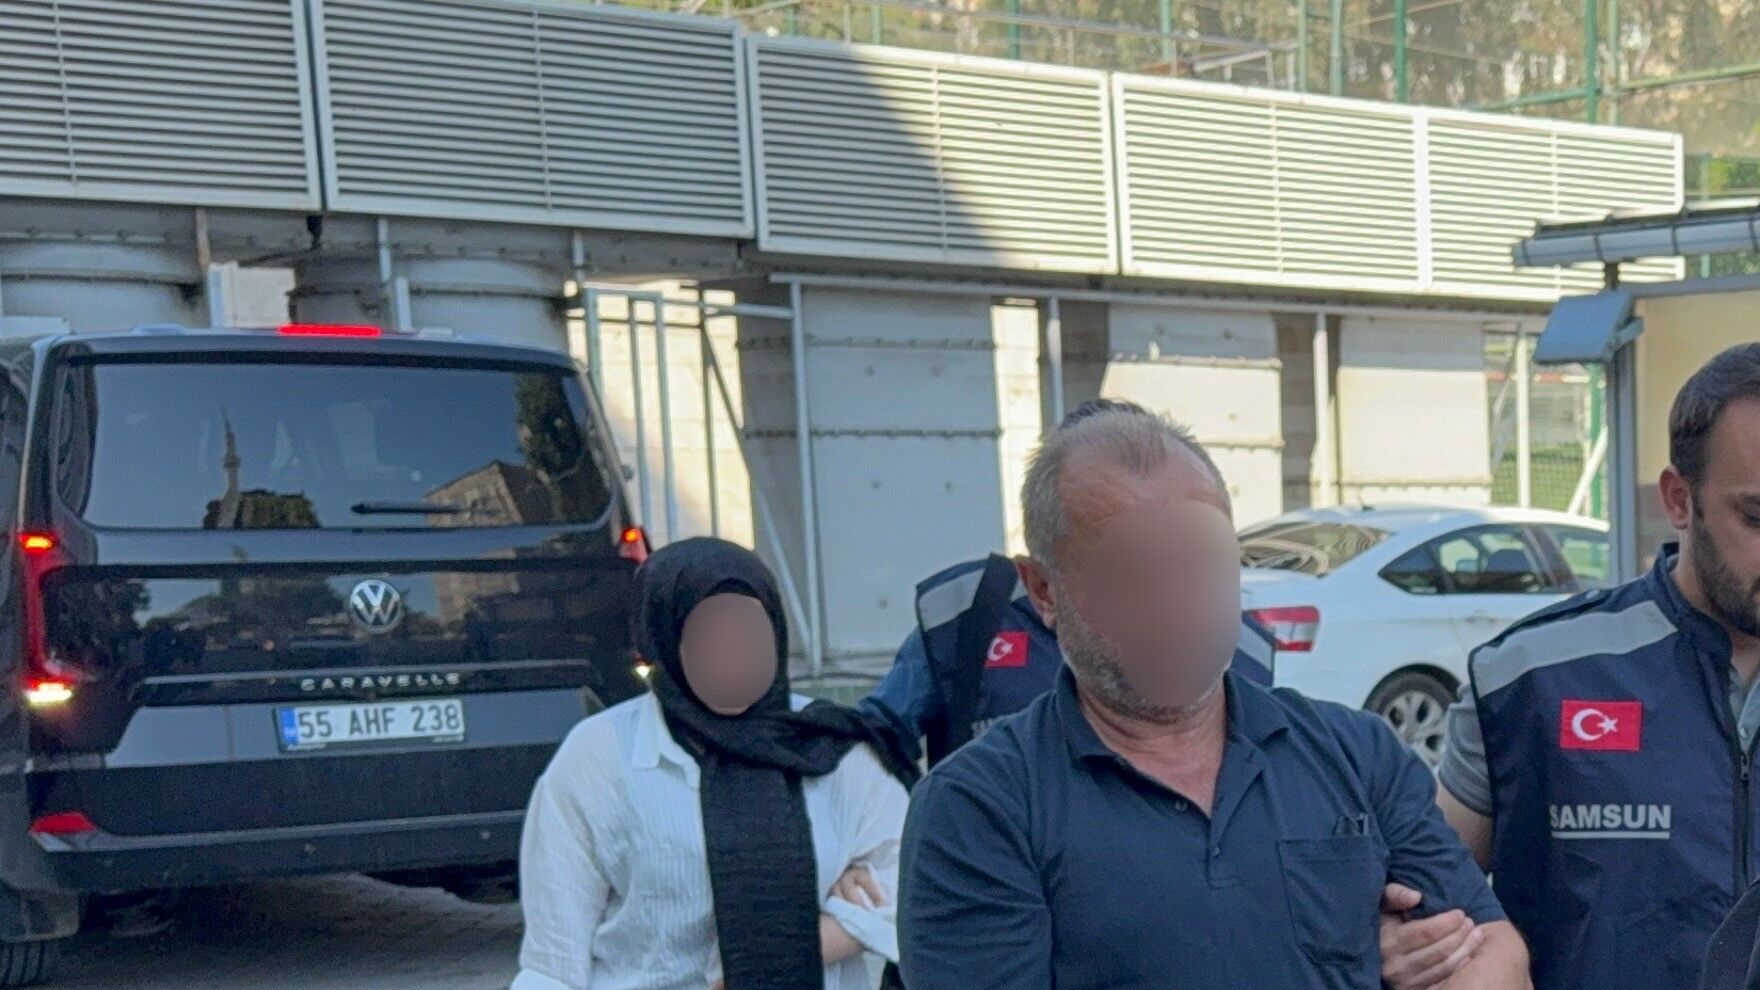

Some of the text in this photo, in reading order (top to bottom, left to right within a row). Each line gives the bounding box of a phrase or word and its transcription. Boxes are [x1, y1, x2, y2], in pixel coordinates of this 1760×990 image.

[301, 672, 460, 691] CARAVELLE
[298, 703, 460, 739] 55 AHF 238
[1550, 804, 1671, 829] SAMSUN
